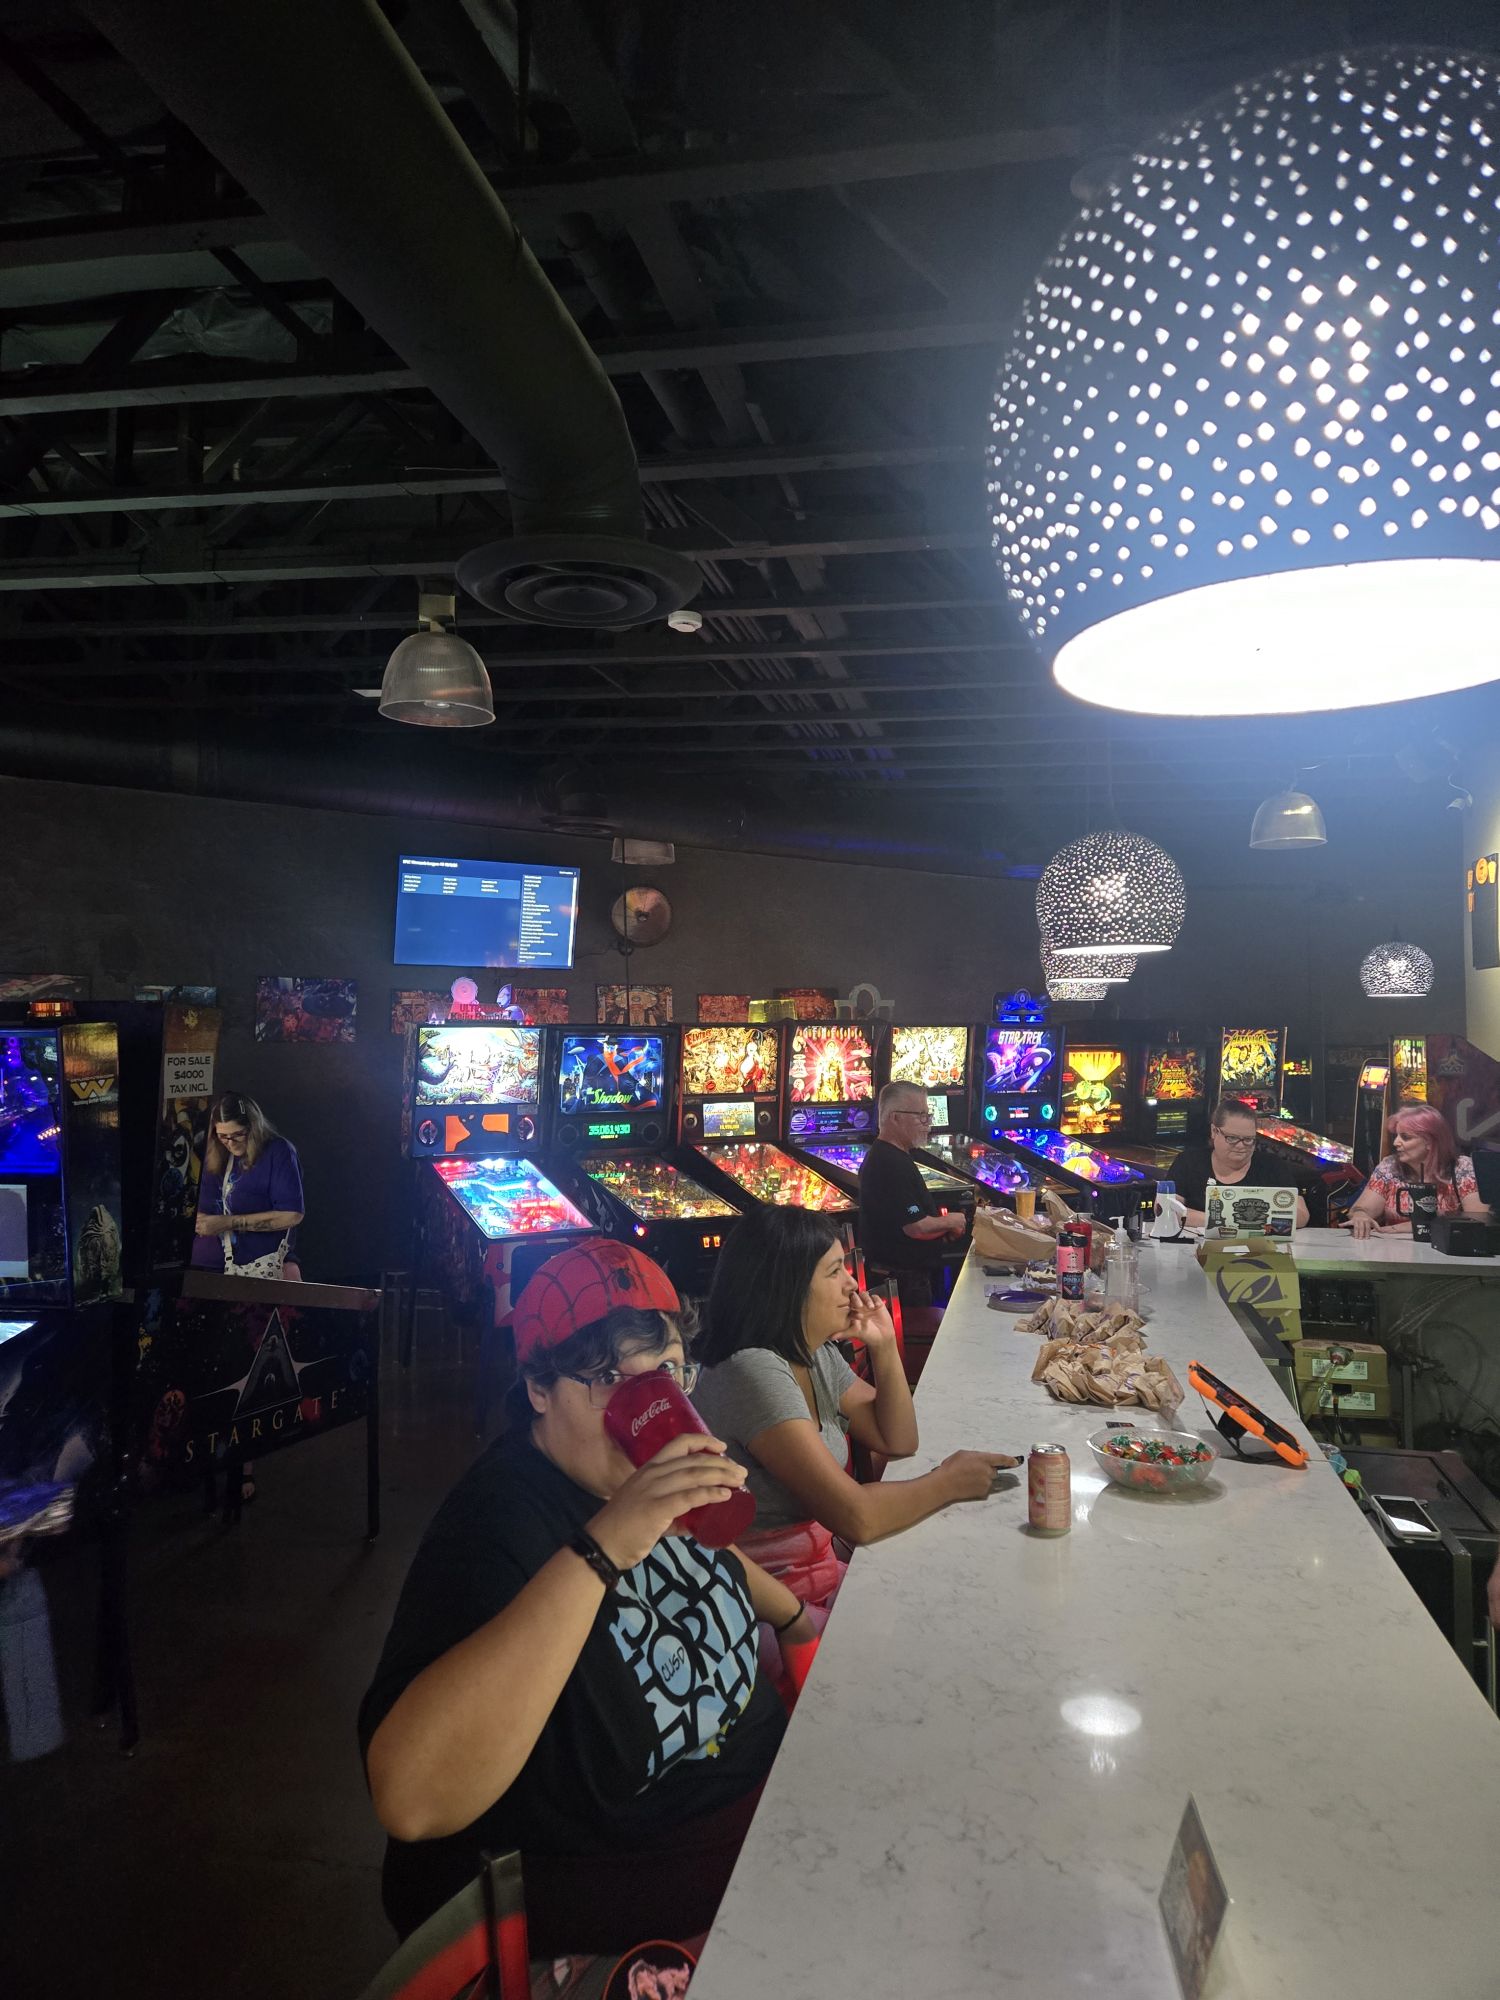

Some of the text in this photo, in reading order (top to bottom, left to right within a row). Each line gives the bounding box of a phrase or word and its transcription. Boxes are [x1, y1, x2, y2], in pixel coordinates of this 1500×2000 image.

[998, 1030, 1044, 1045] STAR TREK
[167, 1056, 211, 1066] FOR SALE
[174, 1070, 204, 1080] $4000
[169, 1083, 208, 1093] TAX INCL
[590, 1088, 633, 1105] Shadow
[631, 1398, 672, 1437] Coca-Cola
[184, 1390, 339, 1463] STARGATE
[660, 1646, 686, 1684] CUSD
